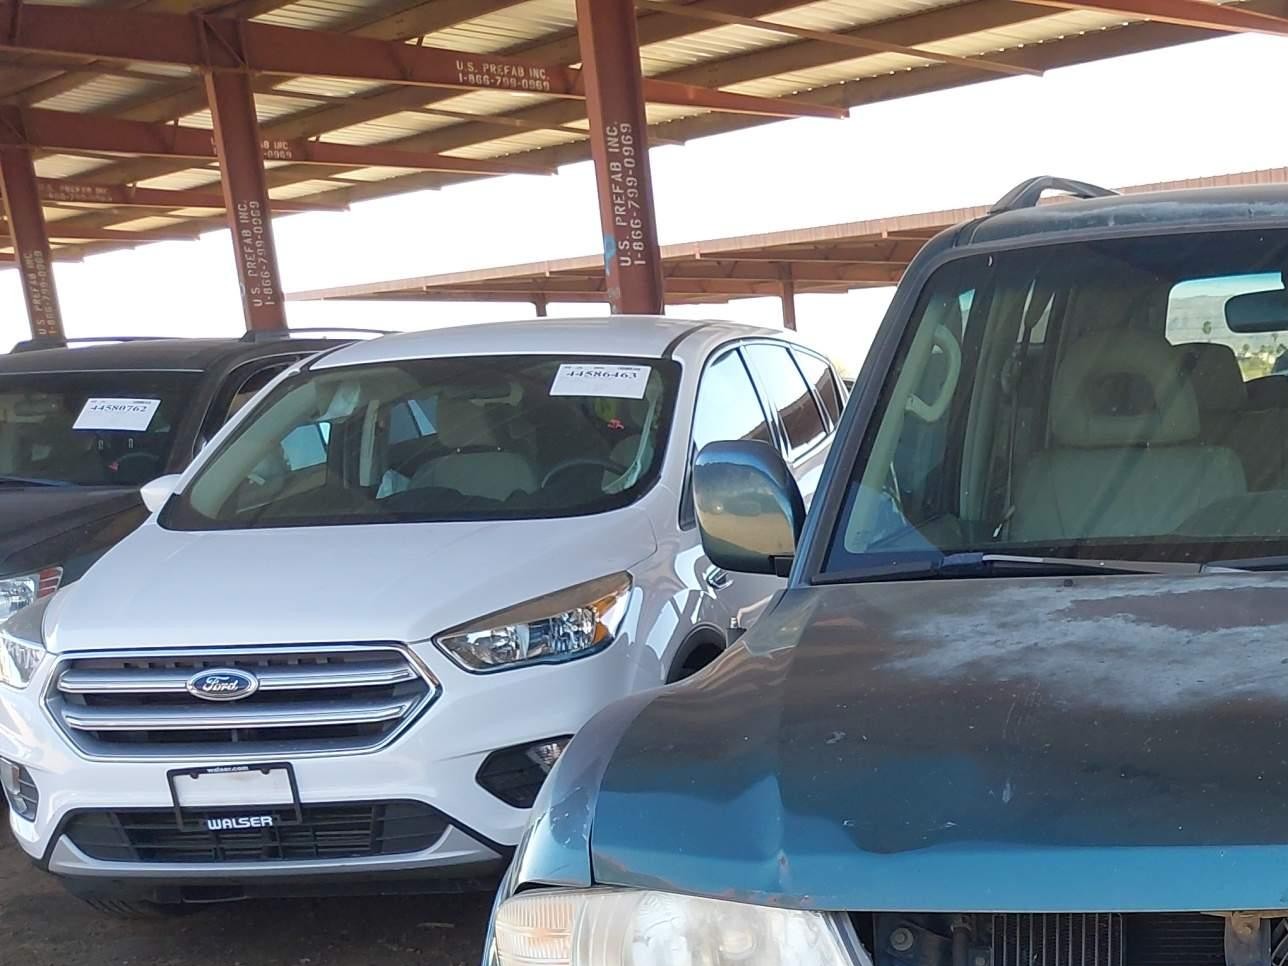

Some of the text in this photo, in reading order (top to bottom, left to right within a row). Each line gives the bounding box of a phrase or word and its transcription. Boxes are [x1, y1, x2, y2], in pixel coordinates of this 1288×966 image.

[482, 63, 525, 77] PREFAB
[606, 121, 632, 266] U.S. PREFAB INC.
[620, 123, 646, 265] 1-866-799-0969
[241, 229, 258, 277] PREFAB
[202, 676, 239, 692] Ford
[207, 816, 273, 830] WALSER
